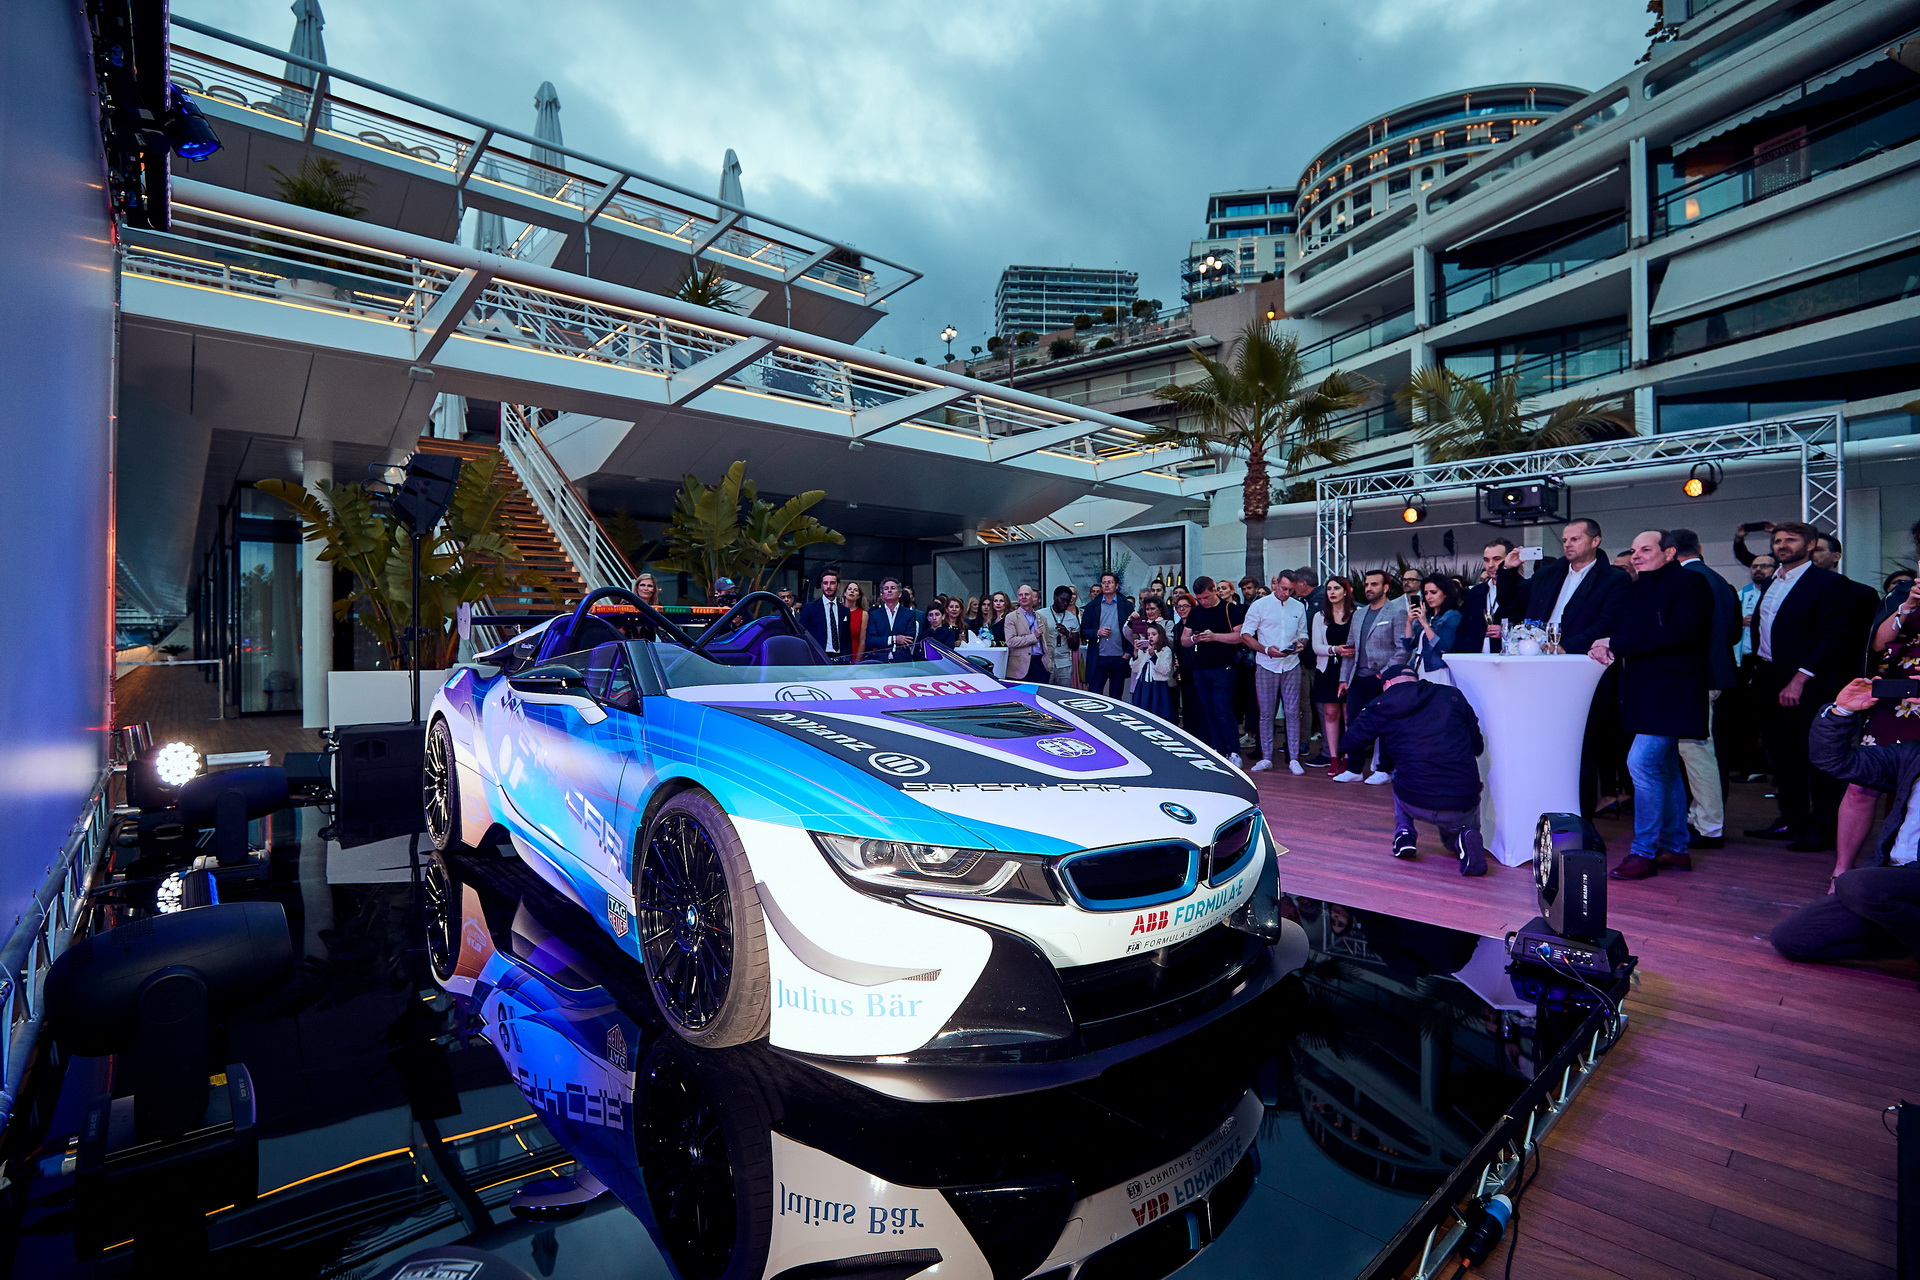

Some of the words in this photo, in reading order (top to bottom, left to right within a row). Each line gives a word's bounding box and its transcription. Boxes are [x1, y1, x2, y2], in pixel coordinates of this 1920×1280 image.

[850, 680, 981, 700] BOSCH
[757, 713, 877, 752] Allianz
[1103, 713, 1235, 777] Allianz
[901, 782, 1048, 792] SAFETY
[1056, 783, 1127, 793] CAR
[609, 897, 626, 919] TAG
[1130, 910, 1169, 936] ABB
[777, 978, 854, 1016] Julius
[865, 993, 923, 1018] Bär
